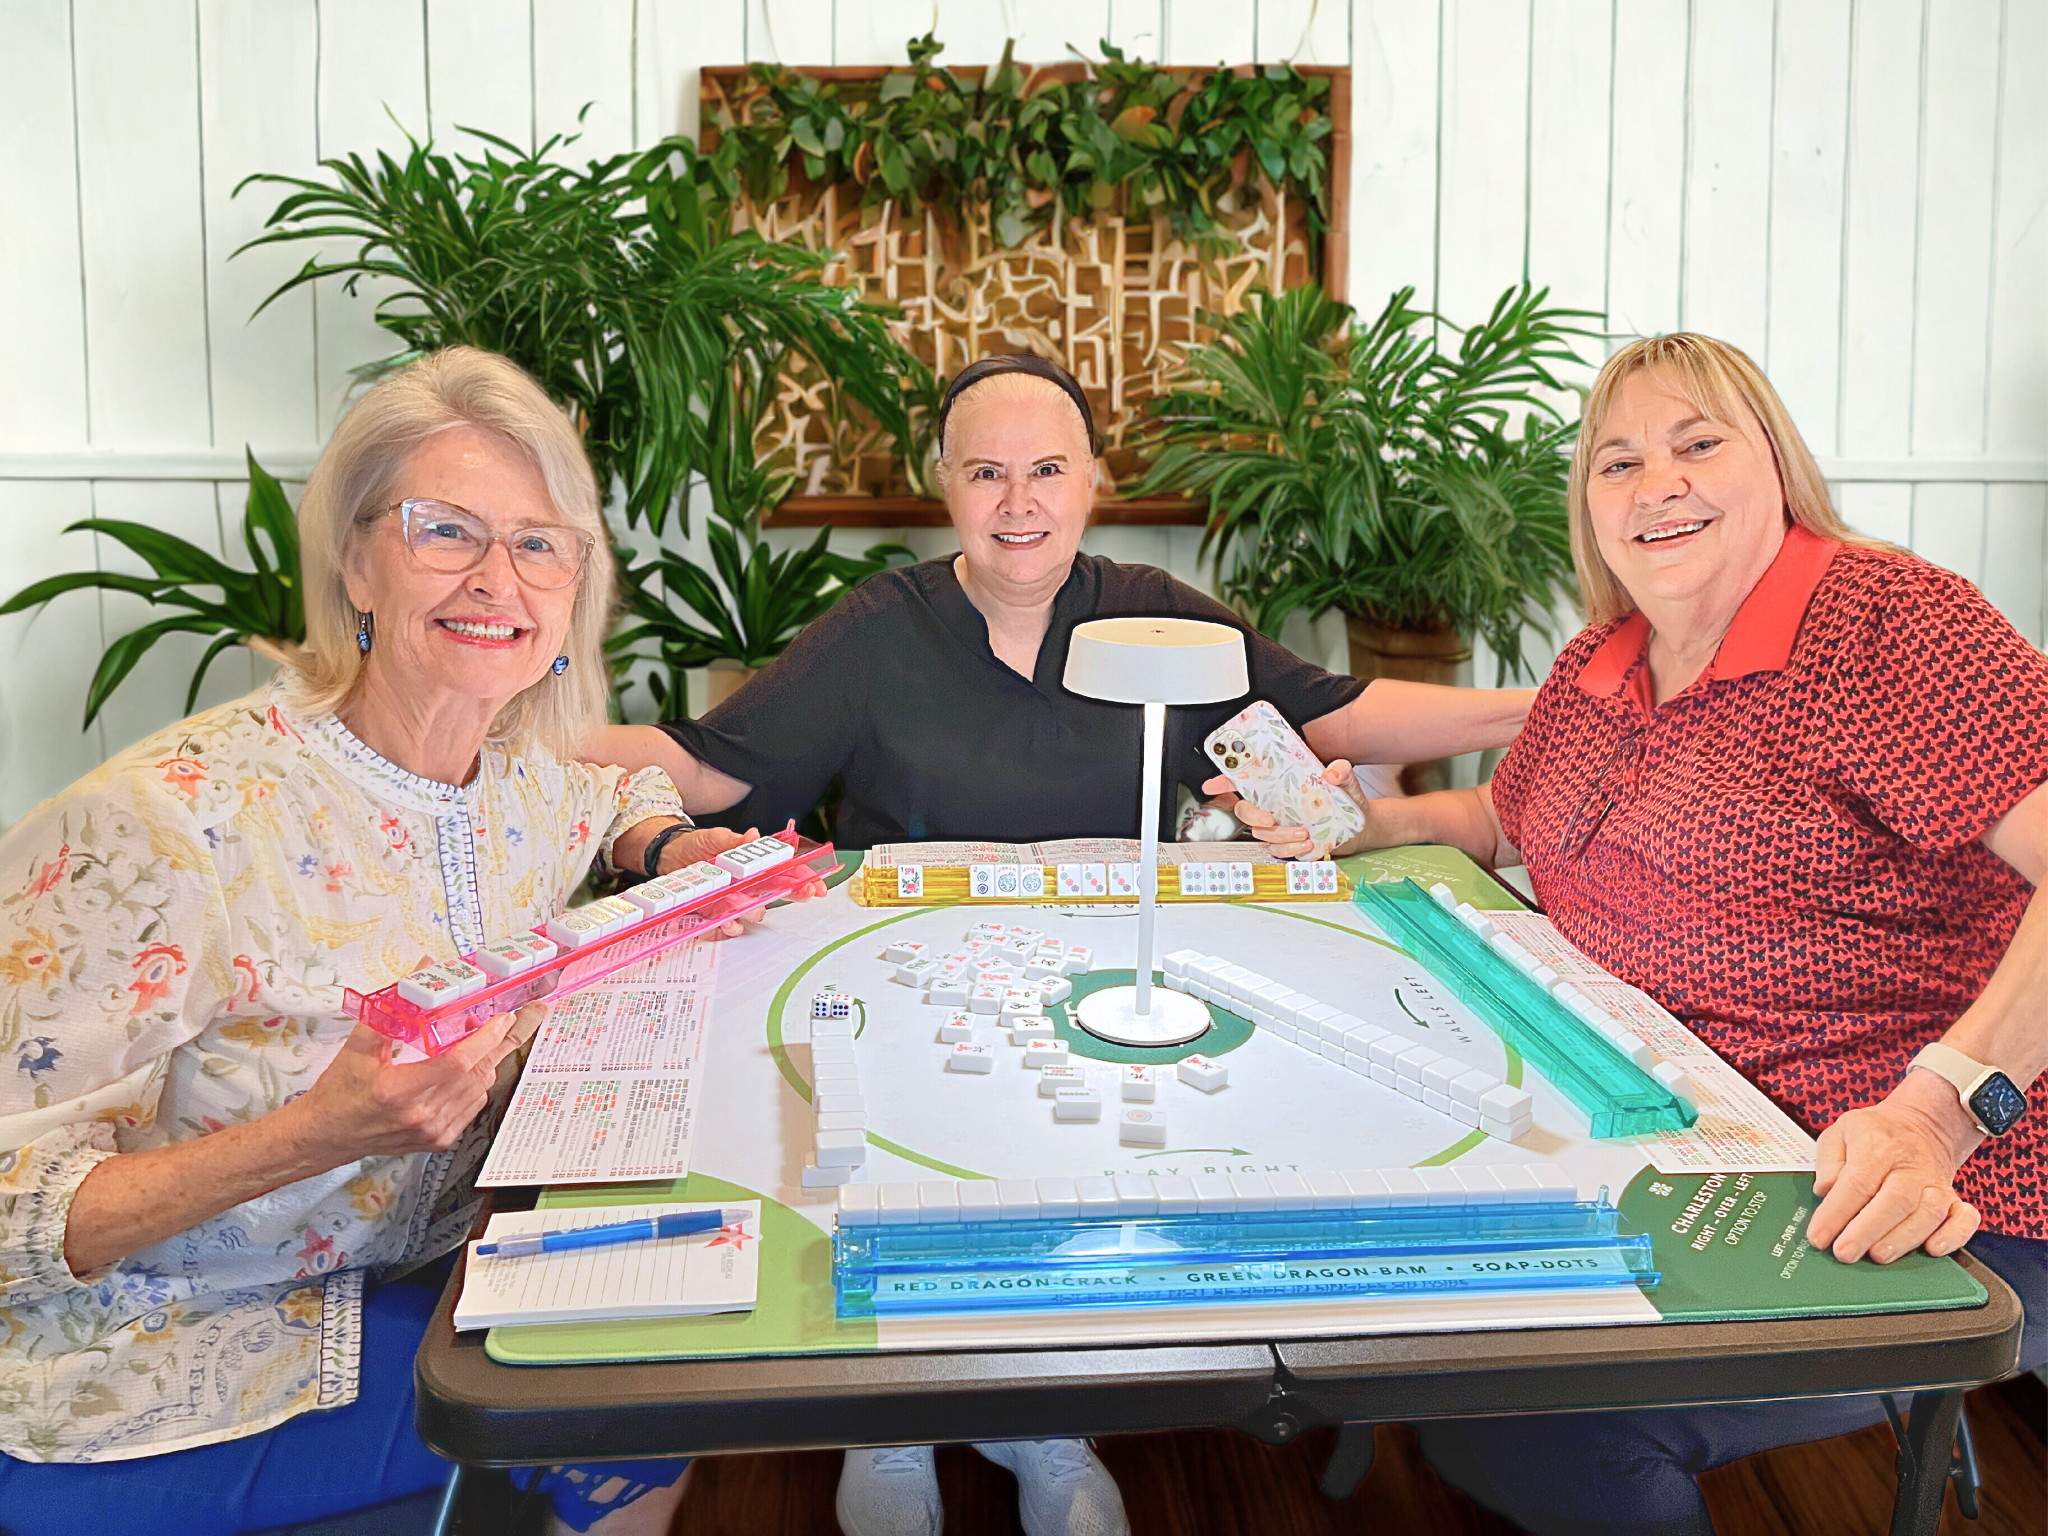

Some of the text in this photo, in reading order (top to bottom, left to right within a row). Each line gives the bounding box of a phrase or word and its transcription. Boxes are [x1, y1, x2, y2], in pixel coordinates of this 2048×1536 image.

[1403, 976, 1473, 1043] WALLS LEFT
[1203, 1165, 1299, 1174] RIGHT
[1671, 1173, 1728, 1234] CHARLESTON
[1690, 1223, 1717, 1251] RIGHT
[1714, 1196, 1738, 1218] OVER
[1733, 1173, 1754, 1191] LEFT
[1724, 1191, 1767, 1245] OPTION TO STOP
[1771, 1242, 1786, 1257] LEFT
[1781, 1225, 1797, 1241] OVER
[894, 1258, 1598, 1292] RED DRAGON-CRACK GREEN DRAGON-BAM SOAP-DOTS
[1780, 1258, 1800, 1279] OPTION
